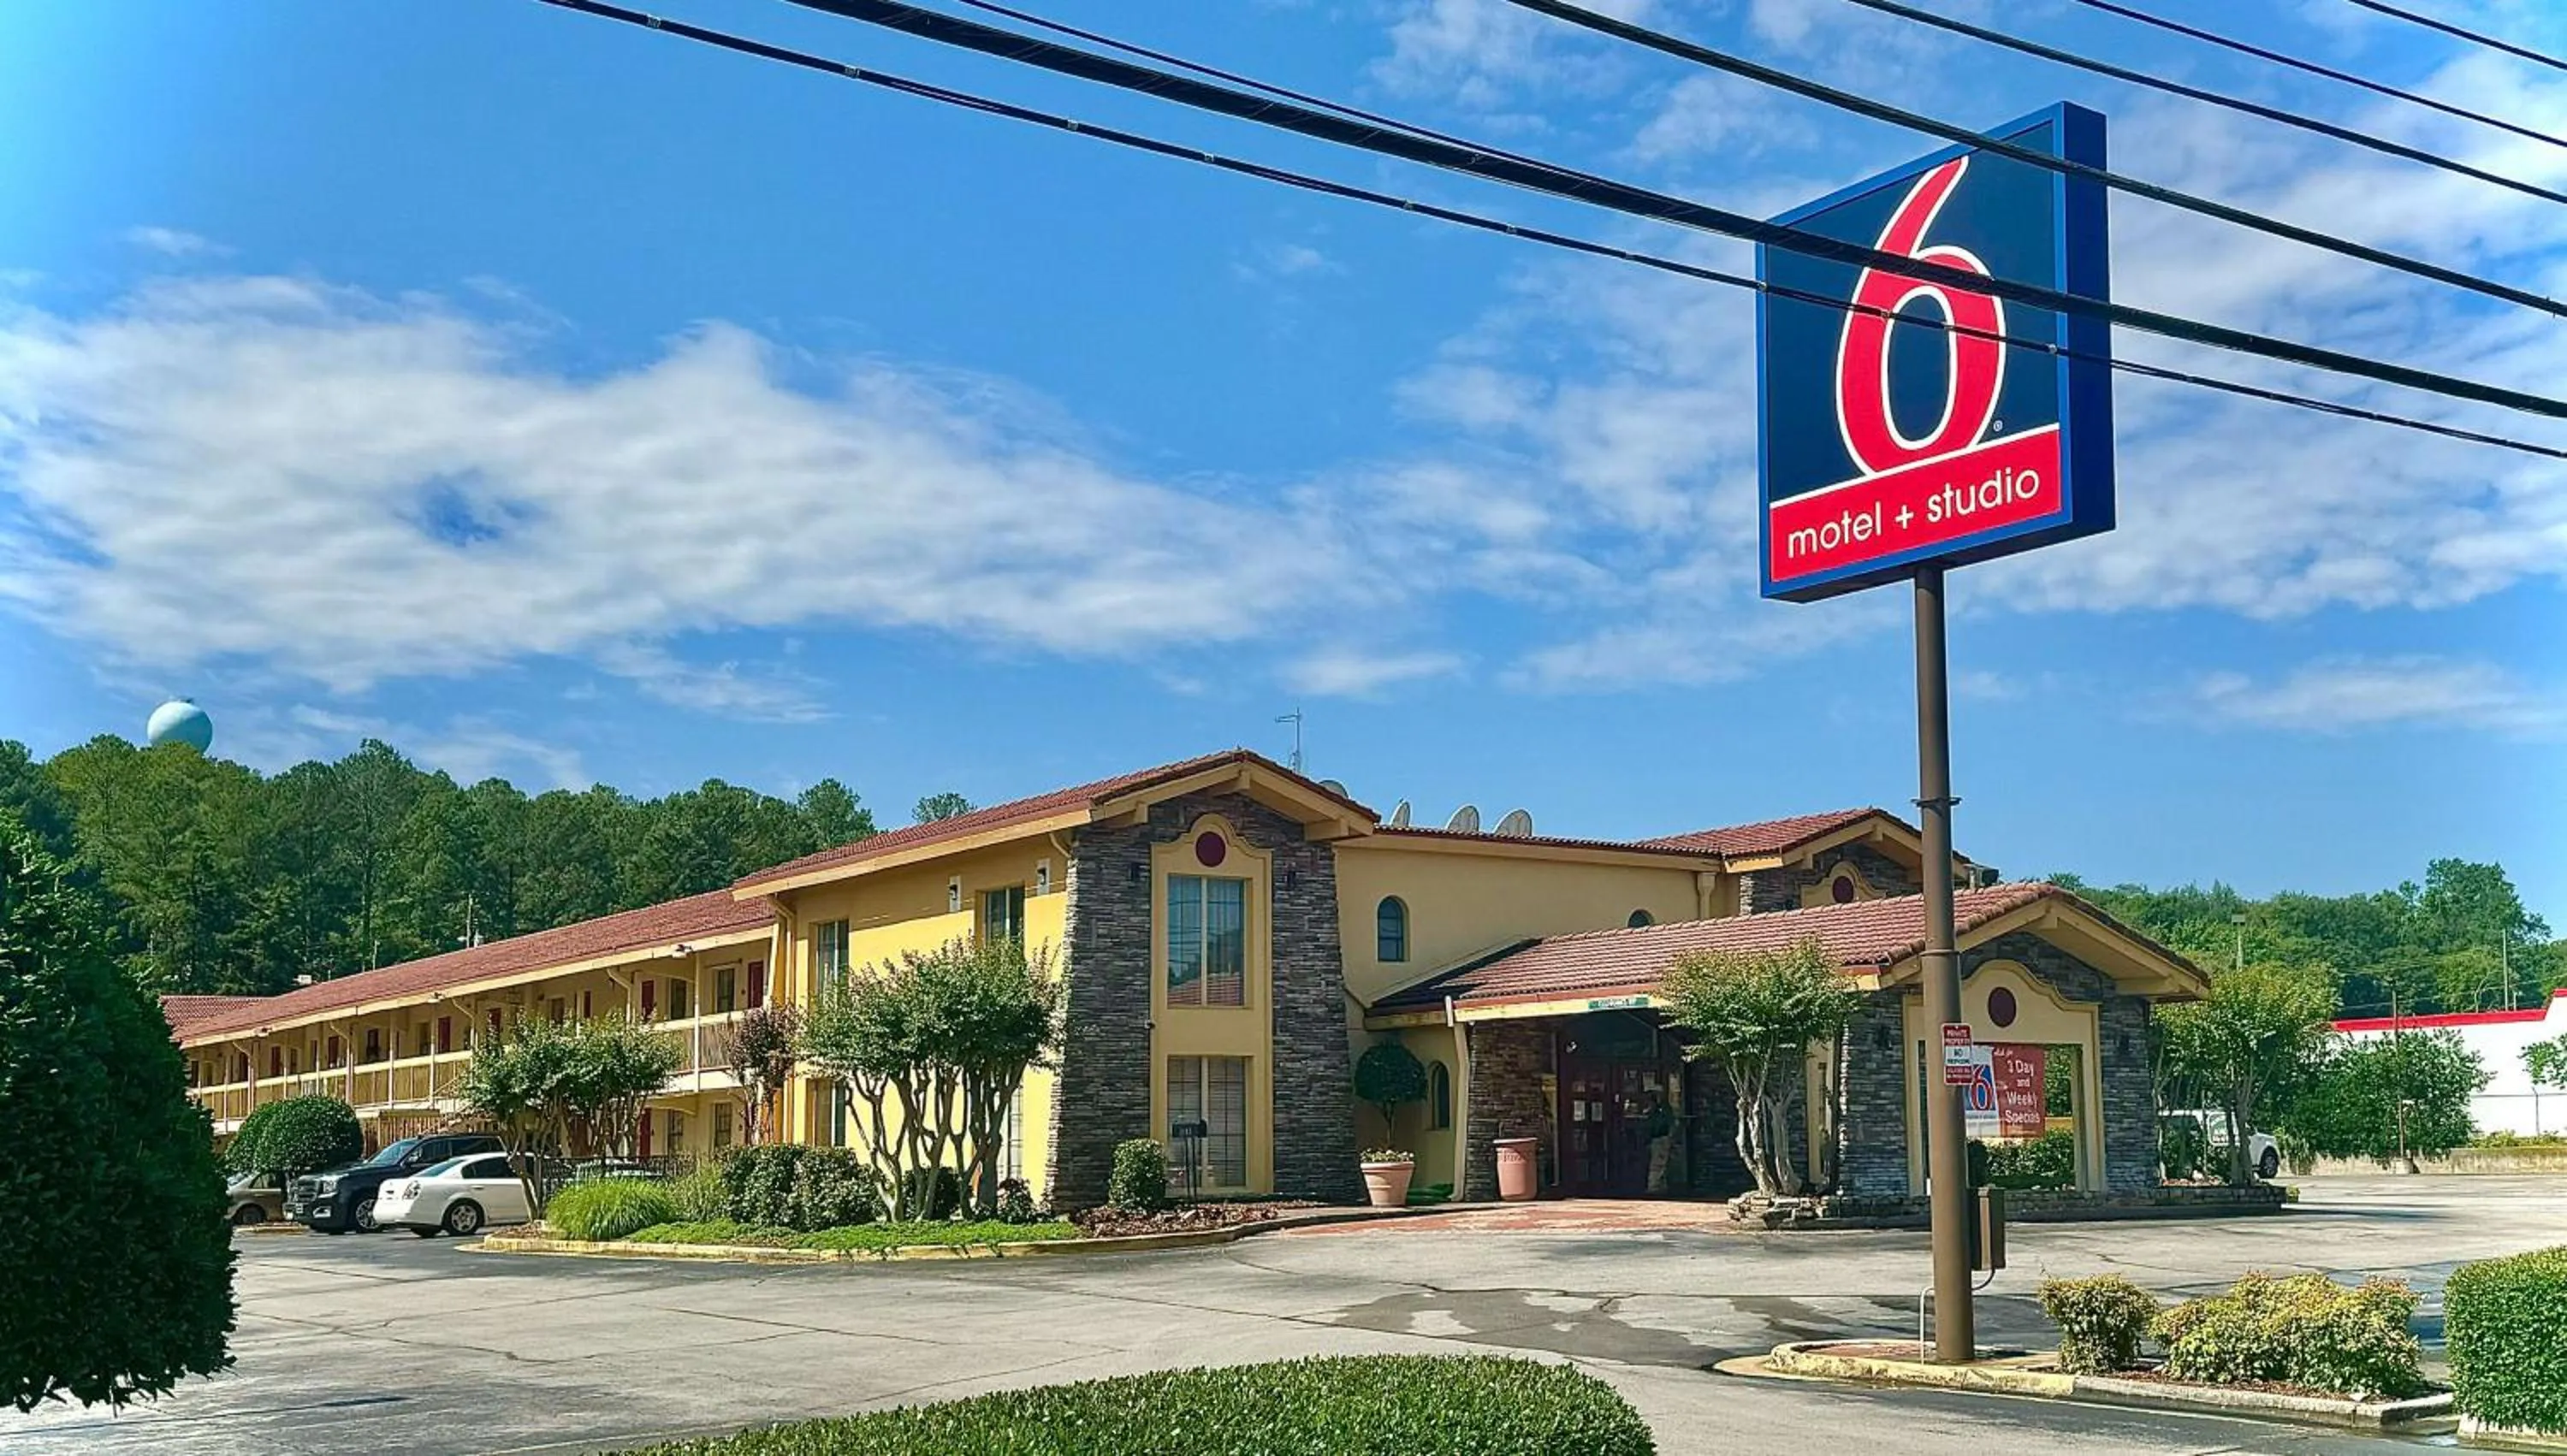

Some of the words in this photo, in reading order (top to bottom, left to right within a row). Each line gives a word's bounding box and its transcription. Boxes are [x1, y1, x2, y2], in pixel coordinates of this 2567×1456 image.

[1835, 155, 2007, 476] 6
[1787, 500, 1882, 559] motel
[1927, 466, 2040, 523] studio
[2015, 1060, 2034, 1077] Day
[1970, 1064, 1993, 1110] 6
[2017, 1078, 2030, 1087] and
[2006, 1091, 2037, 1110] Weekly
[2005, 1110, 2041, 1123] Specials
